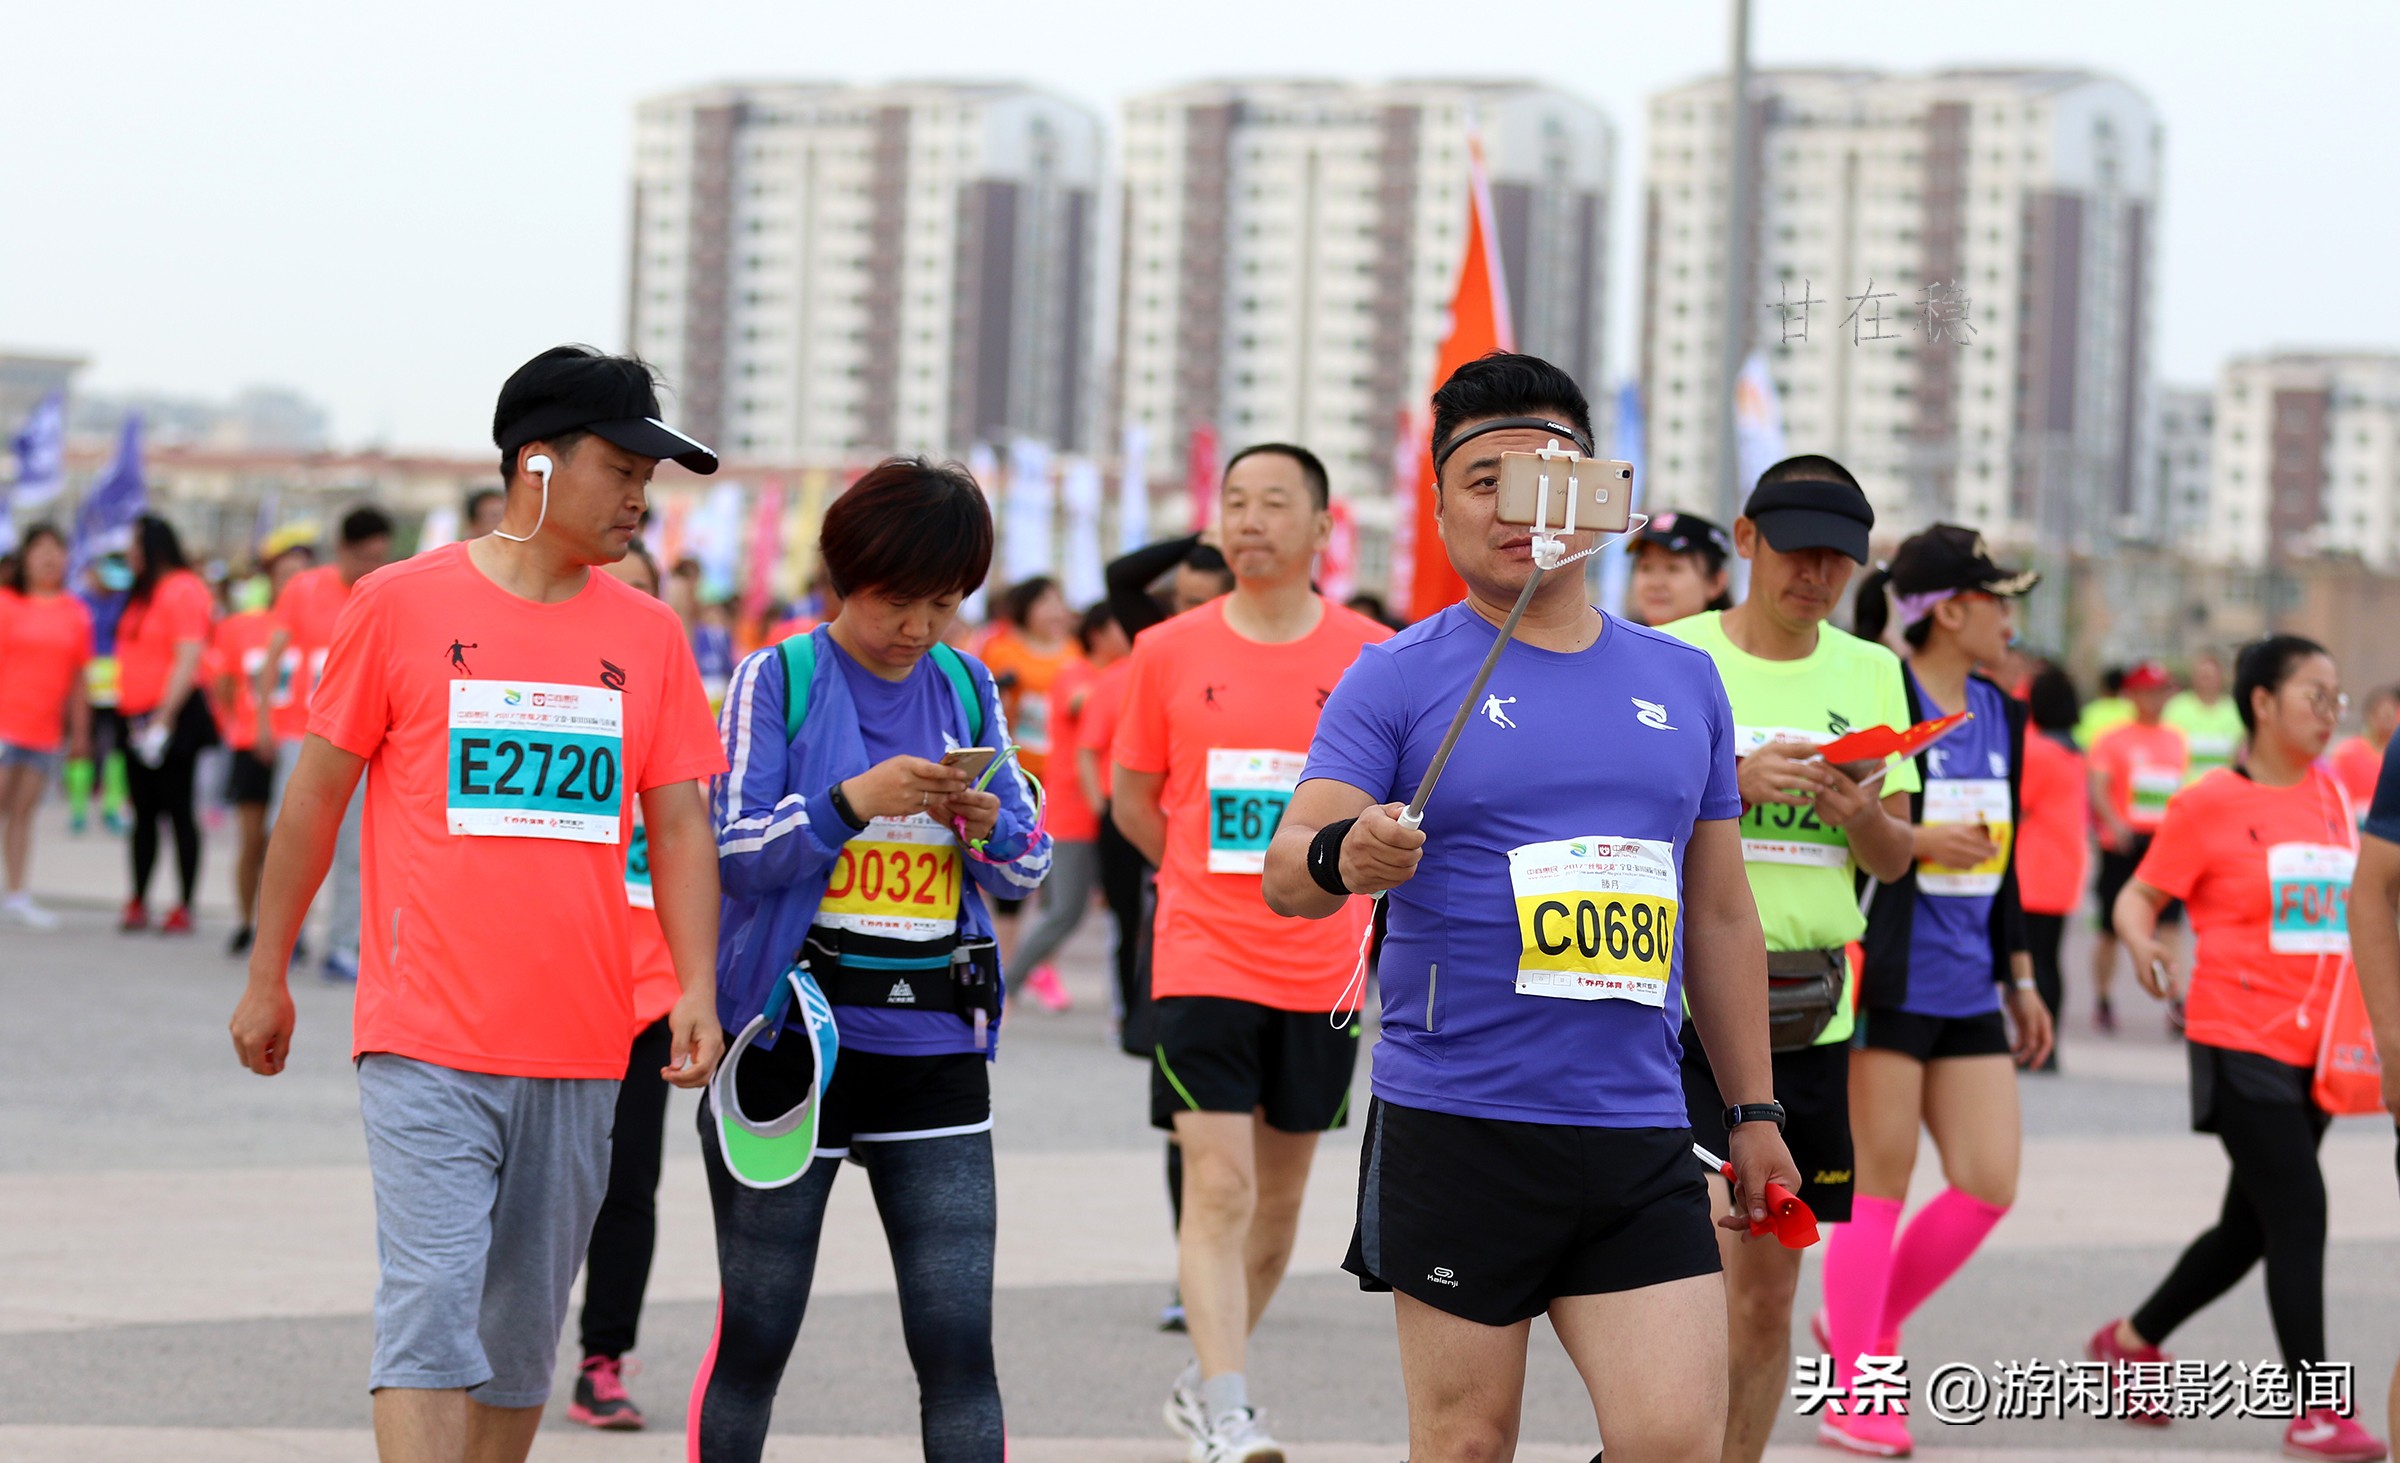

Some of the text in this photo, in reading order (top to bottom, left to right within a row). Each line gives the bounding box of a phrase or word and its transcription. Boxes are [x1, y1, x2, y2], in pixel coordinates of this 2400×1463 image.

[460, 737, 616, 803] E2720
[824, 849, 954, 906] D0321
[1533, 899, 1668, 965] C0680
[1426, 1273, 1459, 1288] Kalenji
